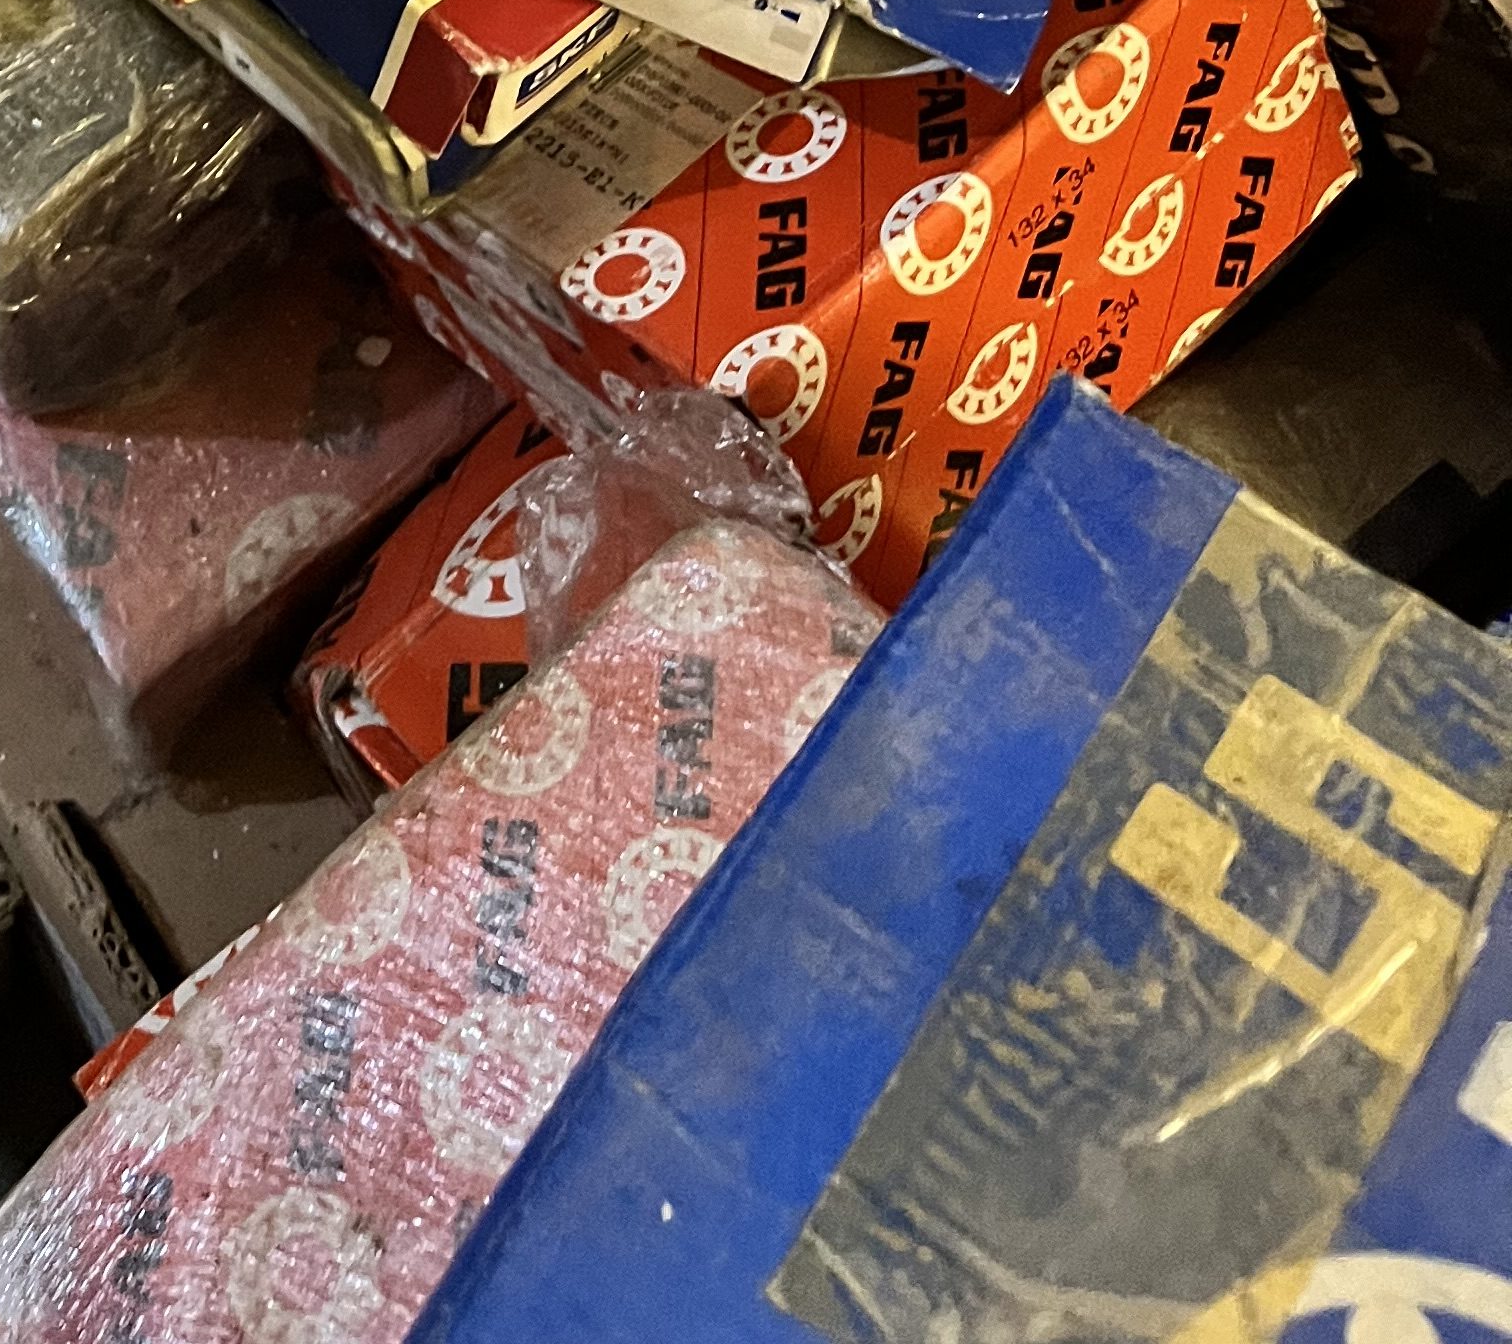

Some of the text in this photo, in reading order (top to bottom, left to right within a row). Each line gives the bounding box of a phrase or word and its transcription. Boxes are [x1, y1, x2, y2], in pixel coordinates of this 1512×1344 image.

[1169, 23, 1243, 154] FAG
[755, 197, 809, 312] FAG
[1007, 204, 1044, 248] 132
[1068, 157, 1095, 190] 34
[1214, 156, 1275, 290] FAG
[857, 320, 930, 459] FAG
[1056, 335, 1094, 372] 32
[1113, 288, 1140, 324] 34
[915, 449, 985, 578] FA
